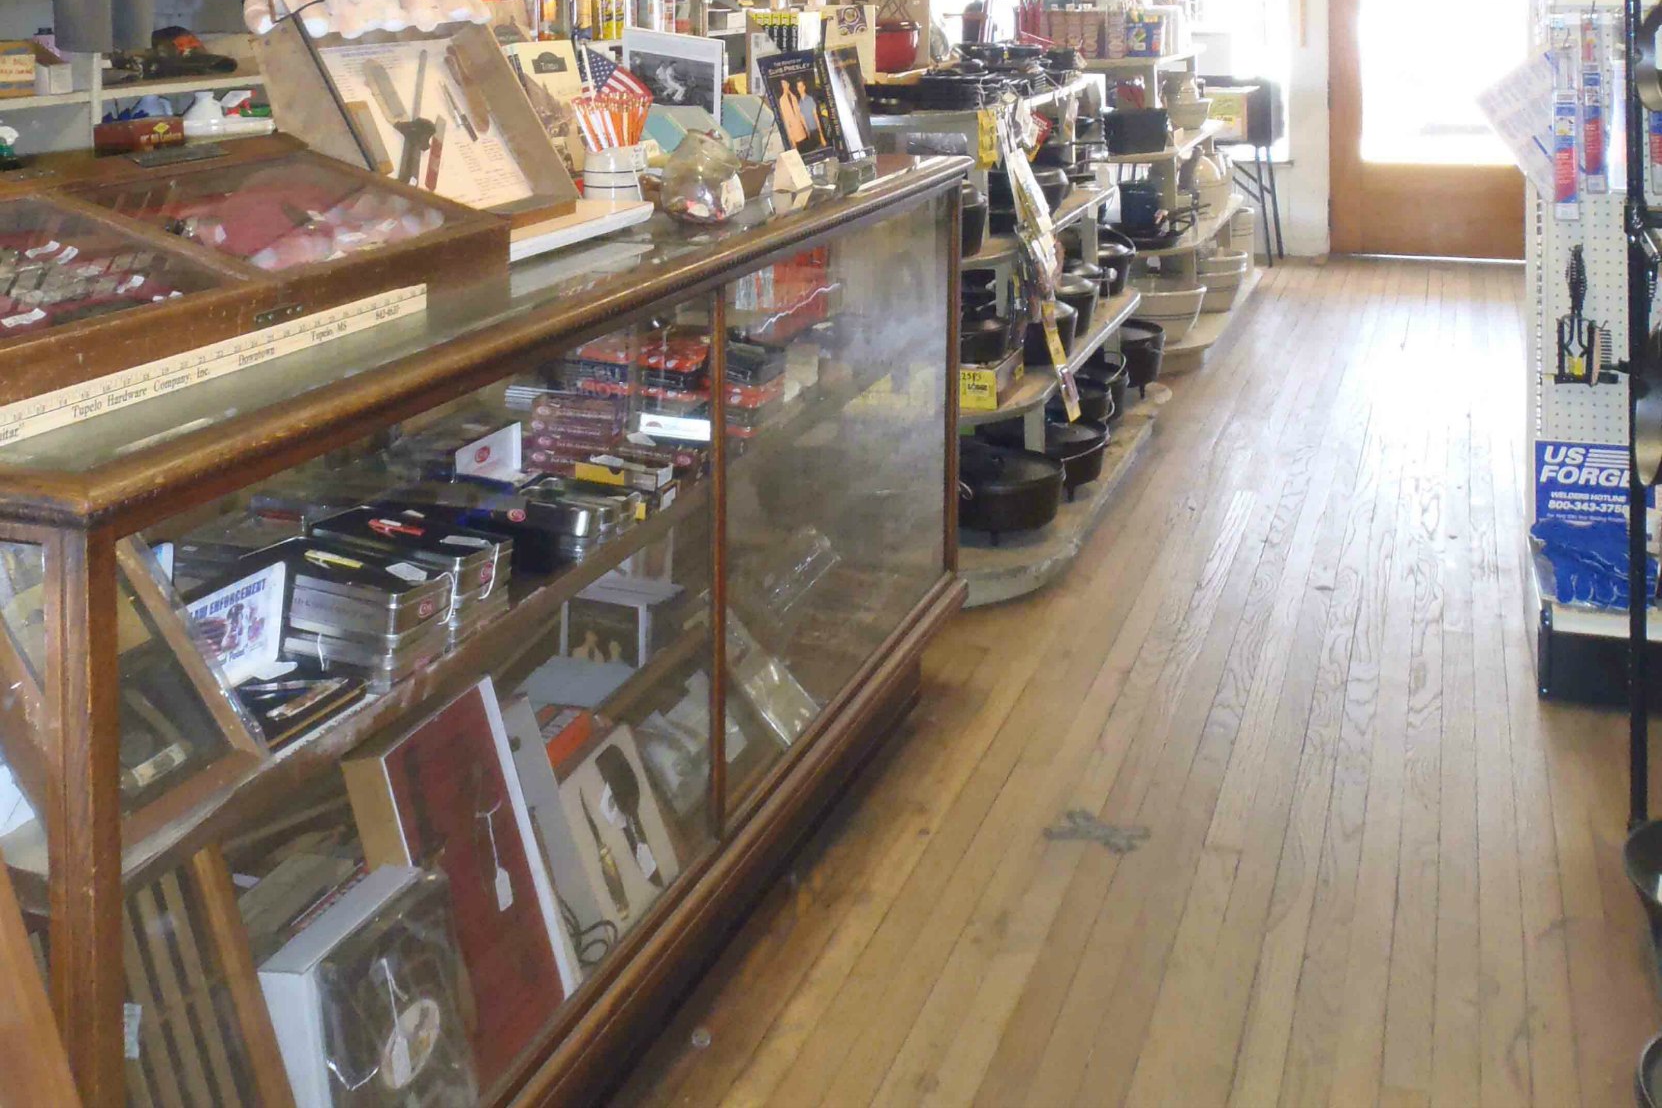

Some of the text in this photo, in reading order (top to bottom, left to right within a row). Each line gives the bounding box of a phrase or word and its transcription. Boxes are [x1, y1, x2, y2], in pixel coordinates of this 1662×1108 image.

[71, 399, 103, 419] Tupelo
[107, 386, 148, 407] Hardware
[196, 366, 211, 380] Inc.
[238, 346, 276, 367] Downtown
[1544, 445, 1586, 465] US
[1551, 491, 1627, 503] WELDERS HOTLINE
[209, 578, 267, 615] ENFORCEMENT
